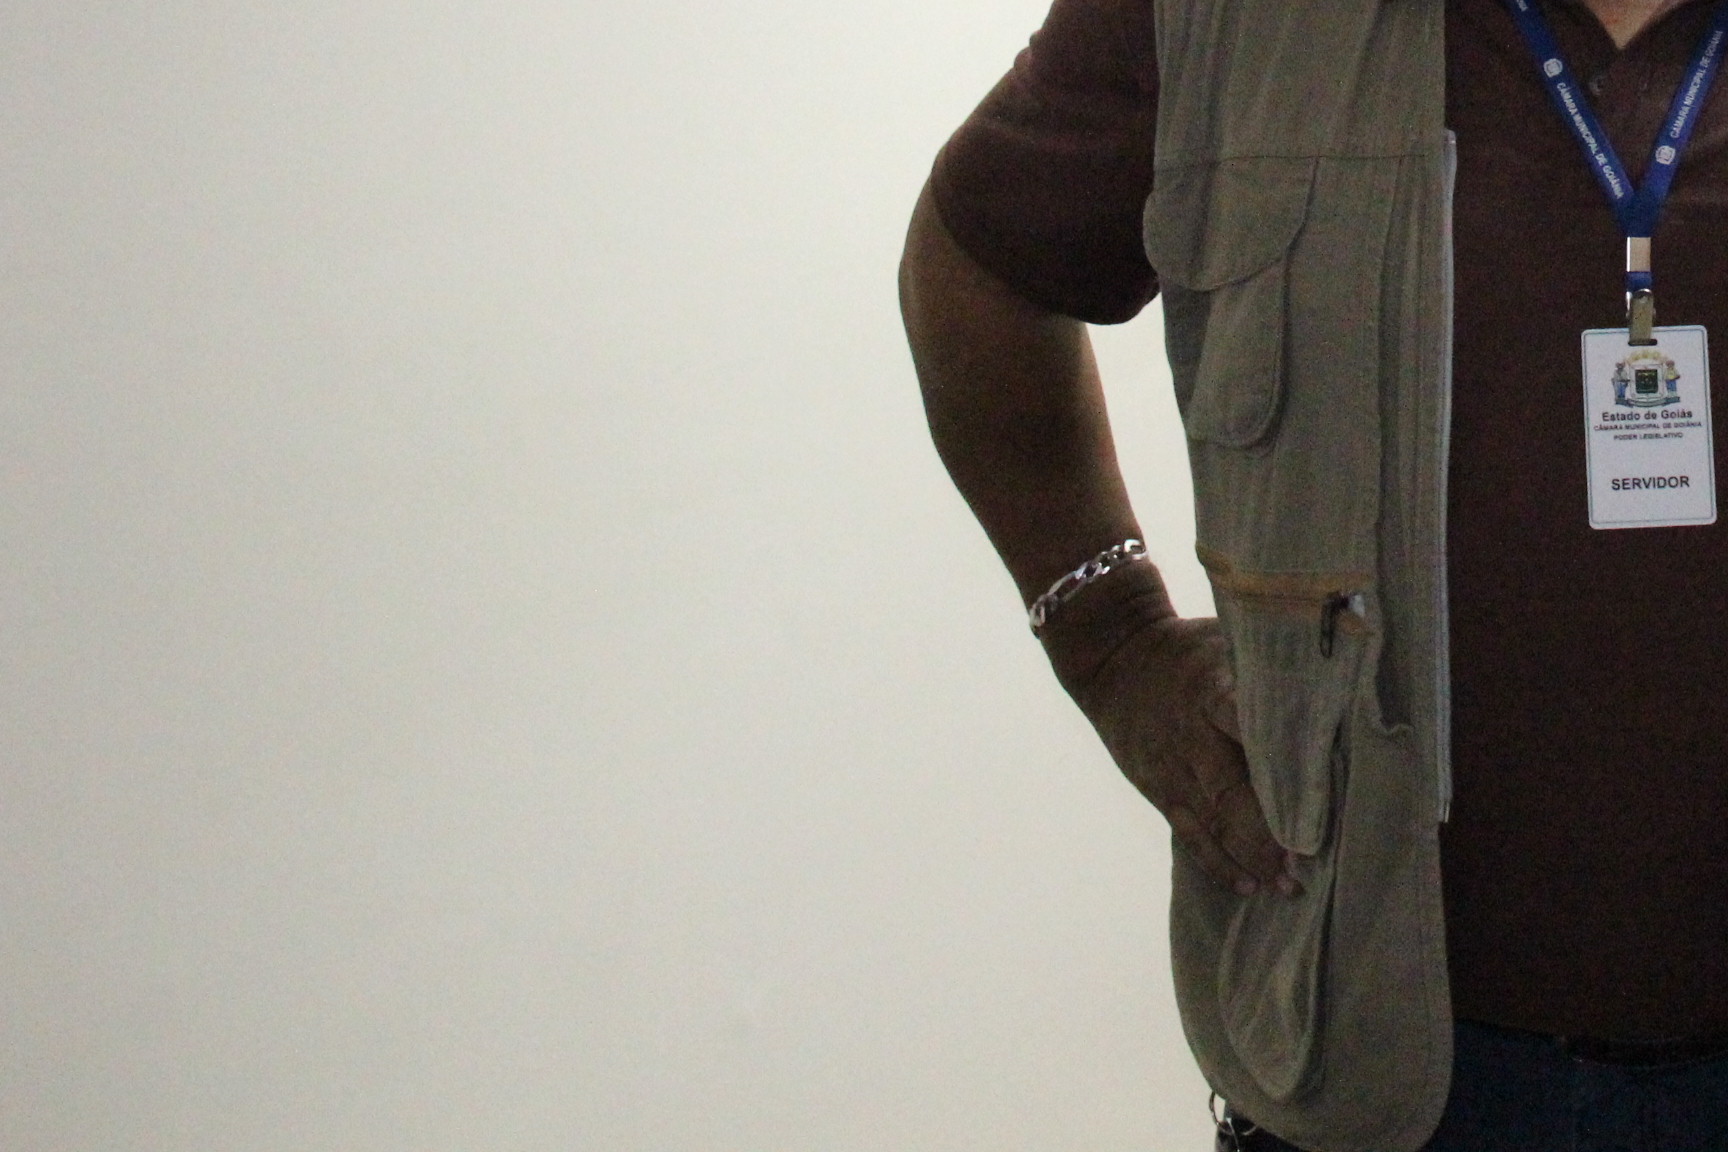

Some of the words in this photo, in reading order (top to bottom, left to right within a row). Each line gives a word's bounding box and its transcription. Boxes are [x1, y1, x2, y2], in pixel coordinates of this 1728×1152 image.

[1699, 56, 1711, 68] DE
[1572, 113, 1598, 155] MUNICIPAL
[1595, 153, 1607, 166] DE
[1602, 411, 1641, 422] Estado
[1644, 410, 1657, 420] de
[1661, 409, 1693, 419] Goiás
[1594, 424, 1623, 432] CÂMARA
[1639, 432, 1684, 440] LEGISLATIVO
[1611, 475, 1690, 491] SERVIDOR
